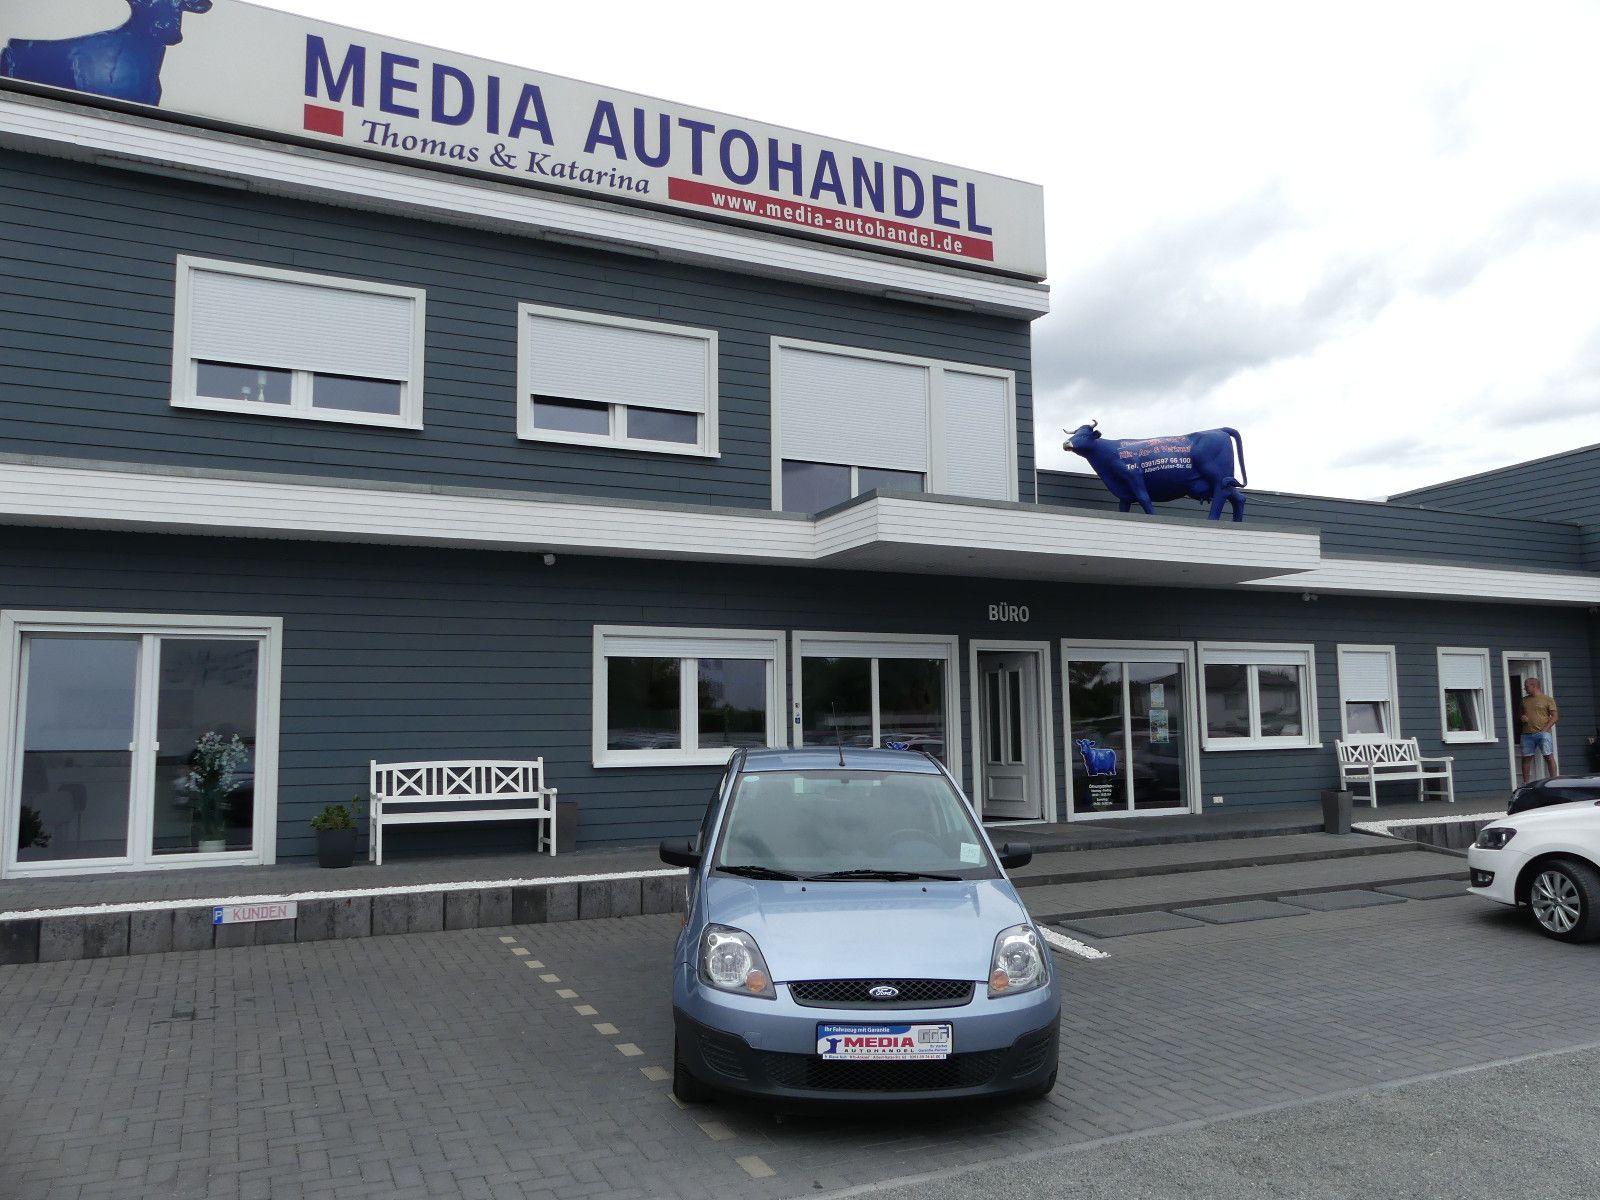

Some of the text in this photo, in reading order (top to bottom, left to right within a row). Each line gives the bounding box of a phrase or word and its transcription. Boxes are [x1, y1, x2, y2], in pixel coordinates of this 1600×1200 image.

[304, 34, 993, 236] MEDIA AUTOHANDEL
[361, 120, 650, 195] Thomas & Katarina
[711, 191, 964, 254] www.media-autohandel.de
[1126, 462, 1139, 471] Tel.
[988, 602, 1030, 623] BÜRO
[233, 905, 287, 921] KUNDEN
[875, 988, 893, 996] Ford
[844, 1037, 914, 1048] MEDIA
